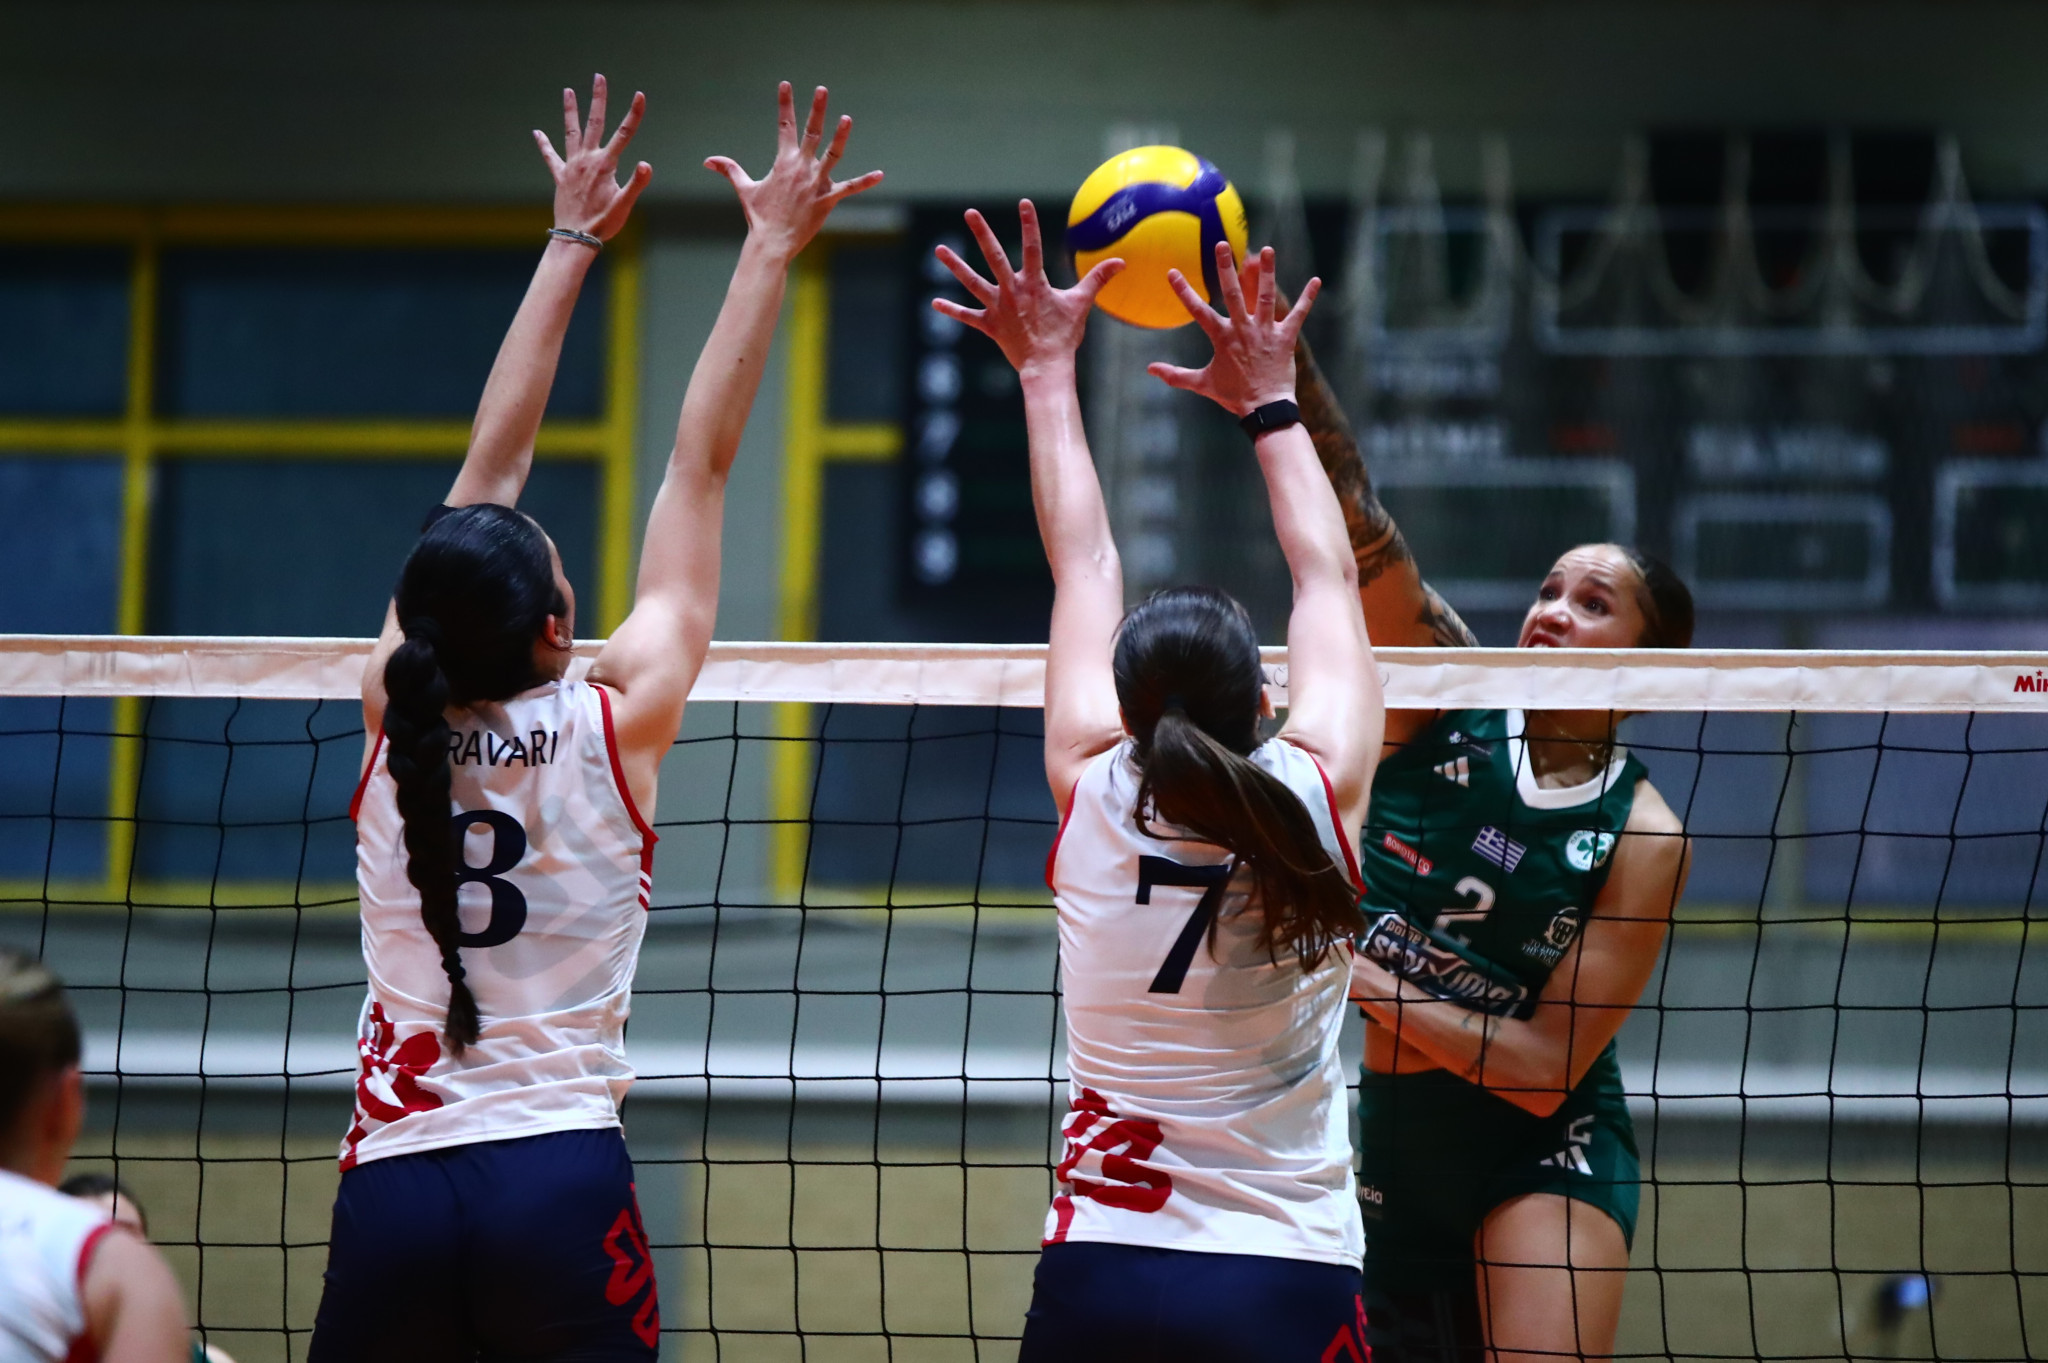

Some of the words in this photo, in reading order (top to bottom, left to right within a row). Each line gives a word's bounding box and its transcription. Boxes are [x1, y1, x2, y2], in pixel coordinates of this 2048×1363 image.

[450, 809, 528, 949] 8
[1136, 855, 1229, 994] 7
[1431, 876, 1497, 946] 2
